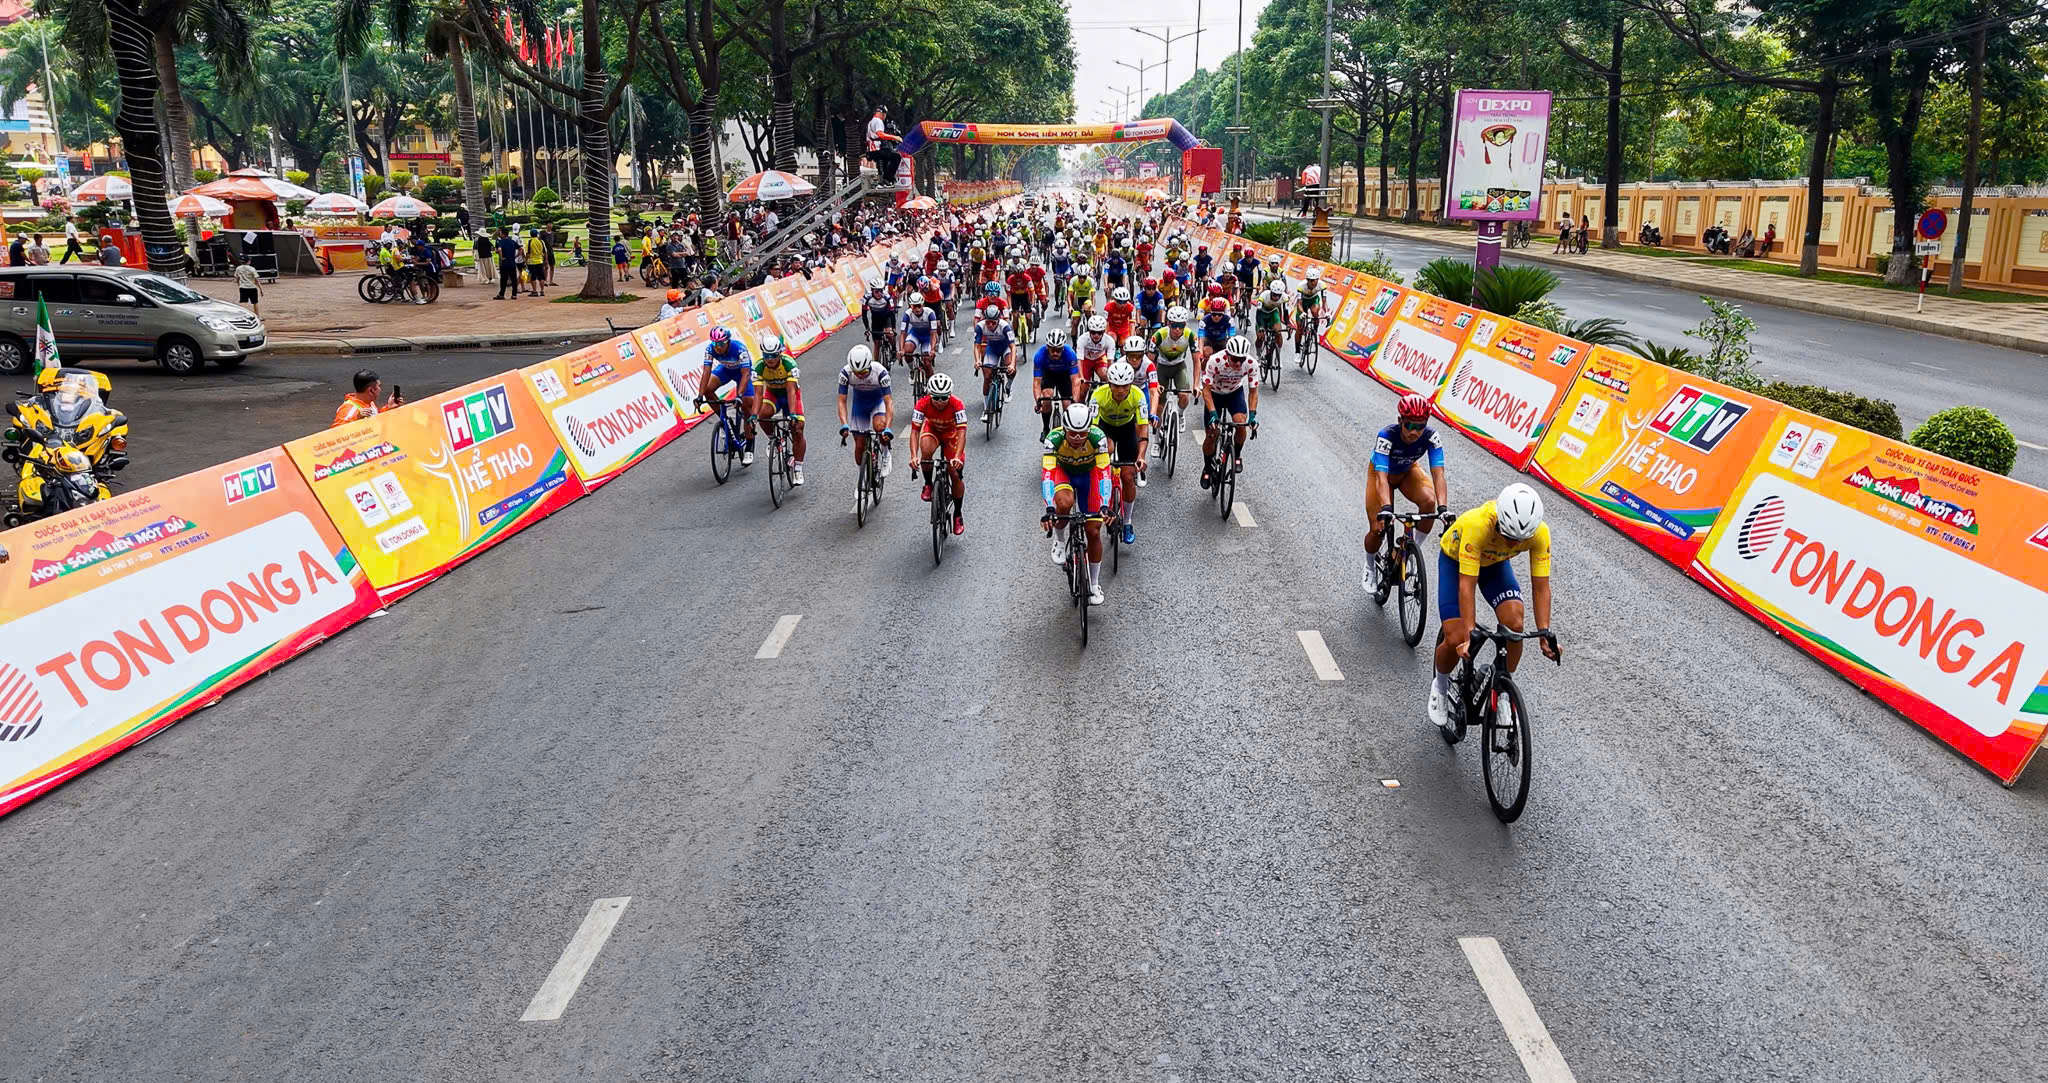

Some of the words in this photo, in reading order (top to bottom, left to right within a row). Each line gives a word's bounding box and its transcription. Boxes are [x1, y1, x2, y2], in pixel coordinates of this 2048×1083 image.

[930, 128, 963, 139] HTV
[1487, 226, 1495, 234] 13
[1391, 342, 1414, 369] TON
[1405, 350, 1437, 381] DONG
[1429, 362, 1444, 386] A
[1549, 344, 1577, 366] HTV
[444, 391, 512, 447] HTV
[587, 412, 625, 448] TON
[616, 395, 658, 435] DONG
[651, 392, 669, 416] A
[1462, 376, 1493, 411] TON
[1484, 387, 1528, 430] DONG
[1517, 407, 1538, 437] A
[1653, 388, 1746, 448] HTV
[487, 443, 533, 481] THAO
[1379, 440, 1389, 451] 74
[225, 464, 275, 501] HTV
[315, 467, 333, 479] NON
[332, 459, 353, 472] SÔNG
[1650, 455, 1697, 495] THAO
[1885, 448, 1904, 460] CUỘC
[1916, 458, 1926, 467] XE
[1925, 461, 1940, 473] ĐẠP
[1940, 465, 1959, 480] TOÀN
[1958, 473, 1980, 487] QUỐC
[1850, 473, 1874, 489] NON
[1873, 480, 1902, 501] SÔNG
[1925, 500, 1953, 520] MỘT
[34, 525, 61, 540] CUỘC
[90, 510, 107, 521] ĐẠP
[106, 503, 128, 517] TOÀN
[128, 496, 152, 509] QUỐC
[388, 534, 403, 545] TON
[401, 526, 420, 540] DONG
[418, 524, 425, 532] A
[1926, 525, 1939, 536] HTV
[32, 561, 66, 582] NON
[66, 547, 108, 568] SÔNG
[135, 525, 164, 545] MỘT
[160, 545, 173, 555] HTV
[36, 618, 175, 708] TON
[161, 563, 301, 654] DONG
[298, 550, 338, 594] A
[1771, 528, 1856, 605] TON
[1841, 567, 1985, 673] DONG
[1968, 640, 2026, 706] A
